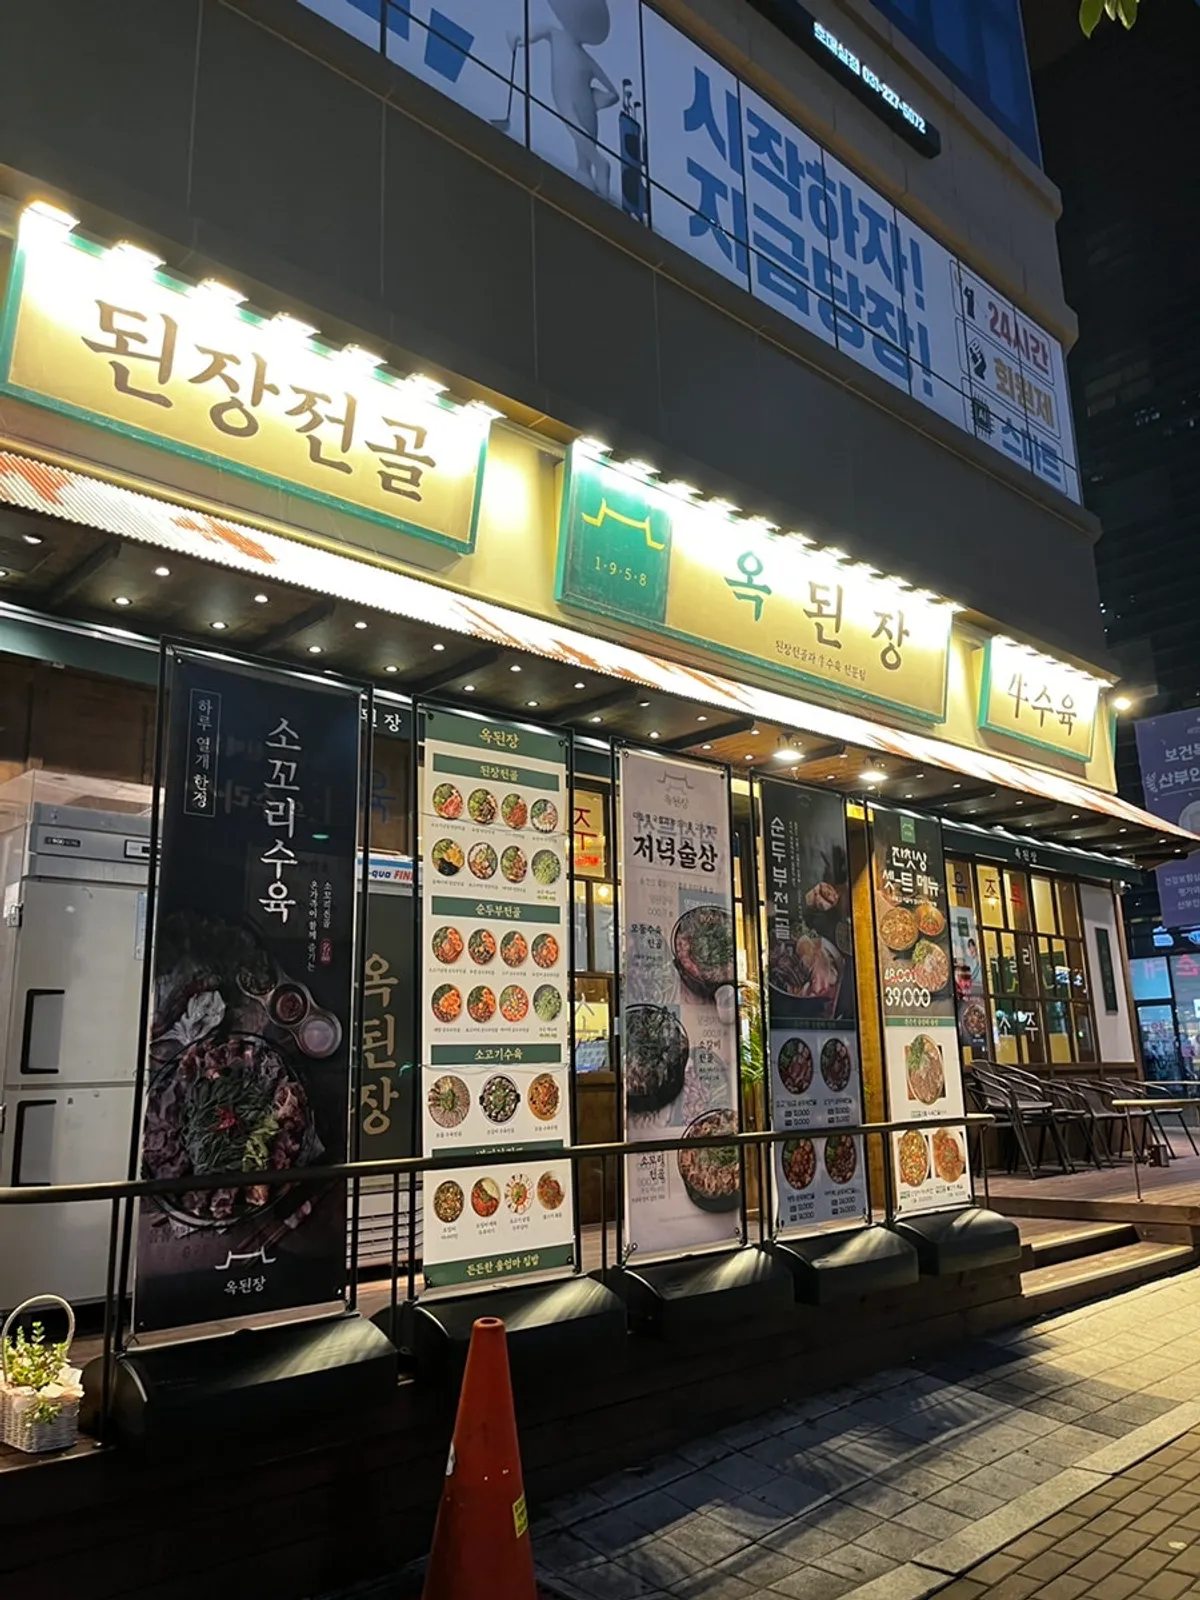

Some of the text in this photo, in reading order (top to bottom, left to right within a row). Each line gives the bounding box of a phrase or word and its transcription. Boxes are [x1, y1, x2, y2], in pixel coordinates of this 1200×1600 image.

[683, 66, 926, 308] 시작하자!
[685, 156, 934, 398] 지금당장!
[988, 301, 1050, 375] 24시간
[80, 298, 437, 501] 된장전골
[993, 357, 1055, 429] 회원제
[1001, 417, 1061, 484] 스마트
[197, 698, 213, 731] 하루
[478, 727, 520, 749] 옥된장
[479, 764, 520, 782] 된장전골
[192, 773, 210, 808] 한정
[258, 717, 302, 923] 소꼬리수육
[632, 834, 719, 873] 저녁술상
[891, 846, 928, 872] 잔칫상
[369, 868, 413, 881] qua FIN
[769, 815, 791, 941] 순두부전골
[916, 873, 940, 898] 메뉴
[475, 902, 522, 919] 순두부전골
[884, 986, 931, 1008] 39,000
[362, 952, 400, 1136] 옥된장
[474, 1047, 523, 1061] 소고기수육
[466, 1260, 493, 1277] 든든한
[522, 1252, 540, 1267] 집밥
[223, 1275, 267, 1297] 옥된장
